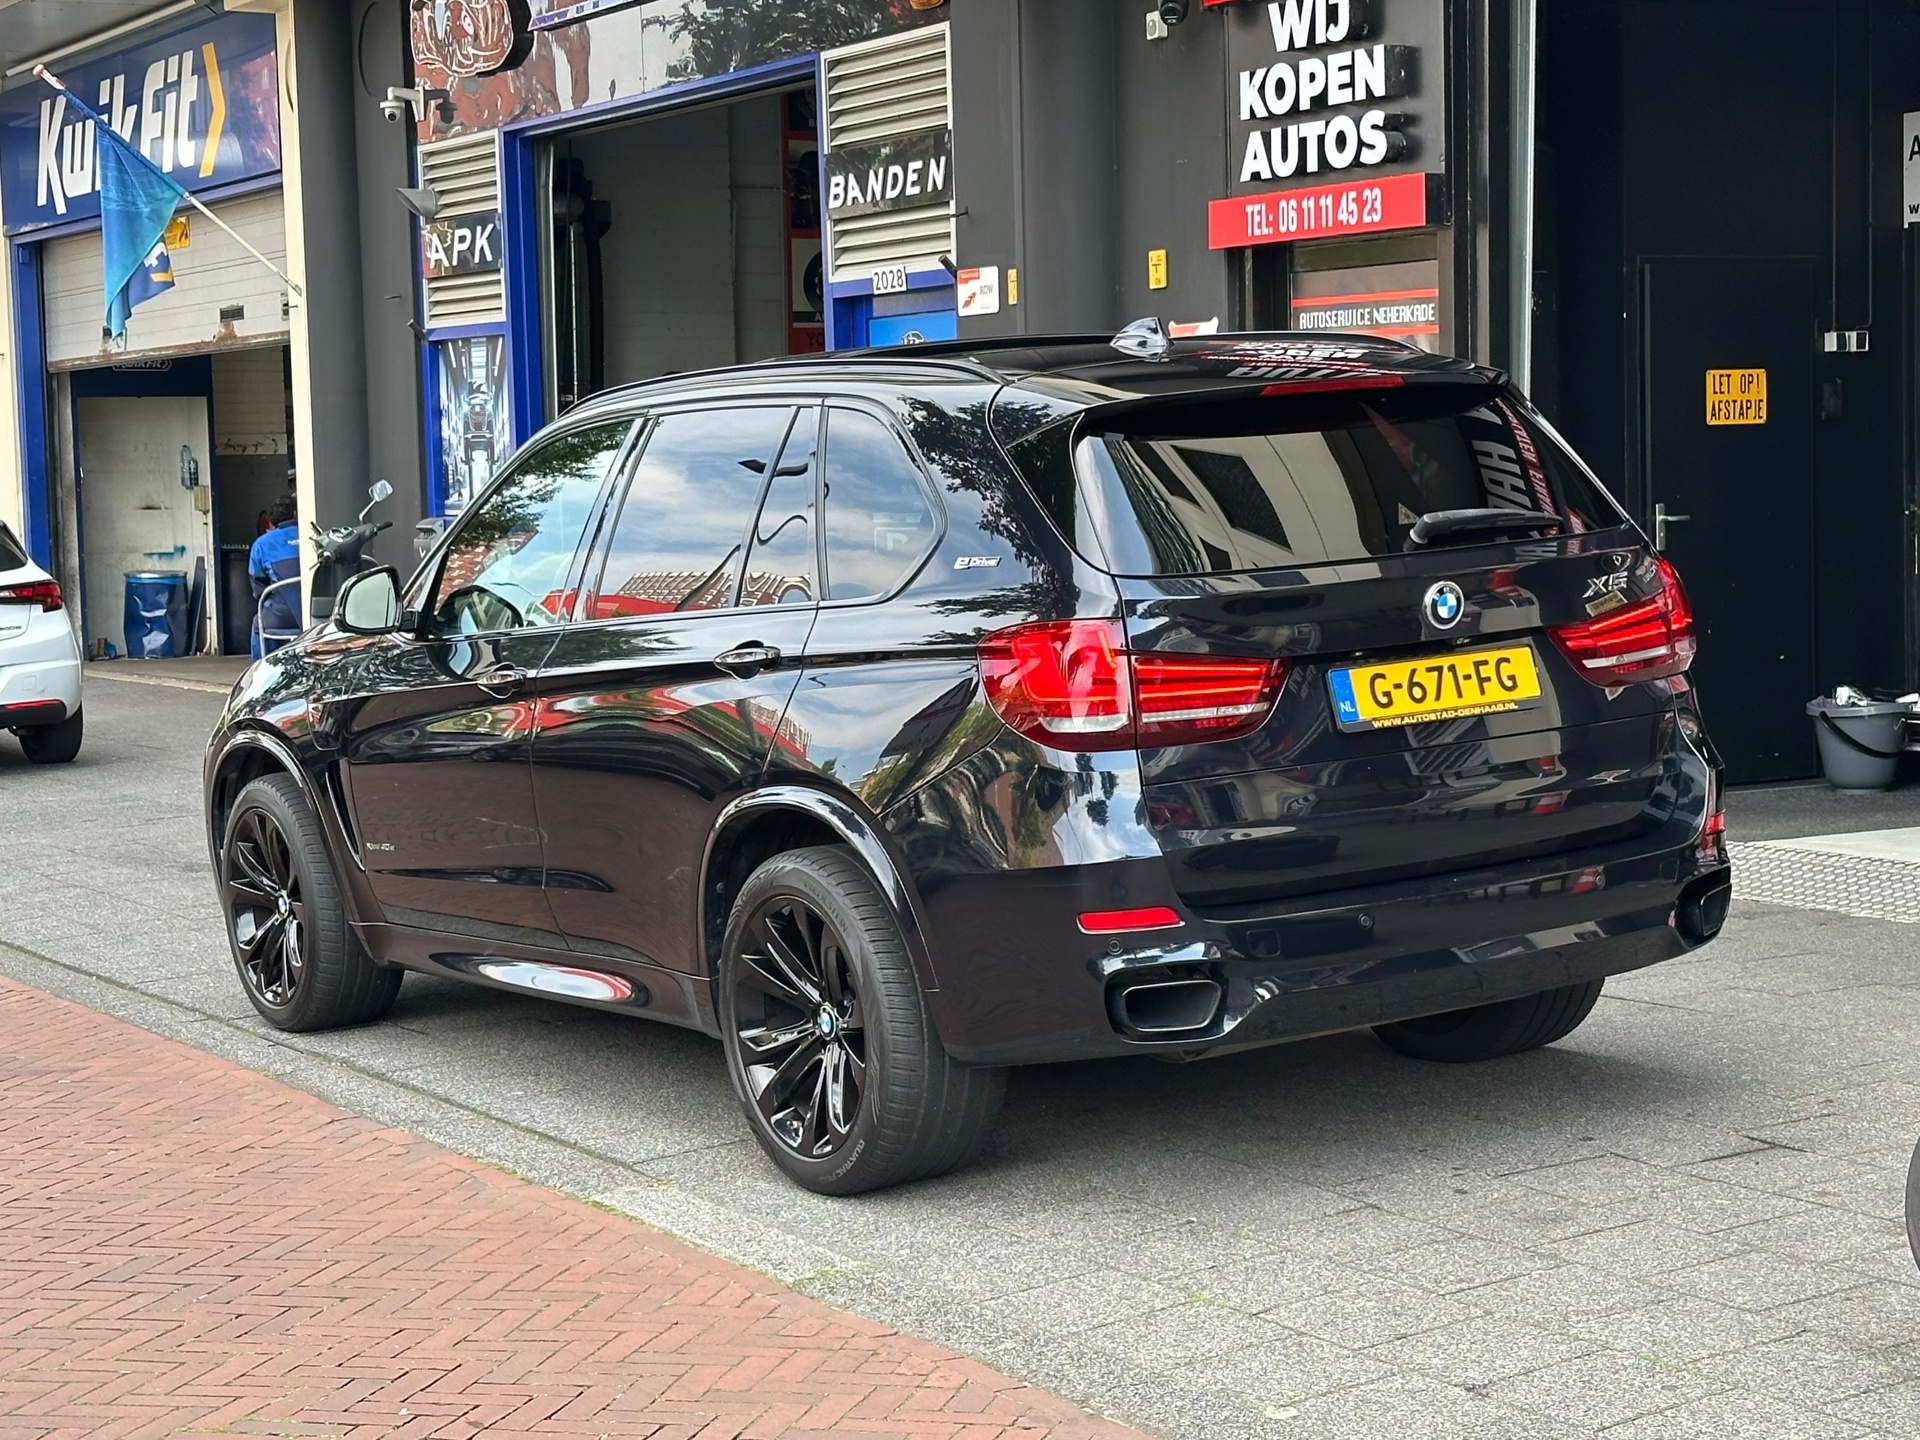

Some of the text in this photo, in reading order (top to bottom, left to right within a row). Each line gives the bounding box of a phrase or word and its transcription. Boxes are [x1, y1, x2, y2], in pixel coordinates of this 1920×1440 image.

[1268, 0, 1350, 52] WIJ
[1239, 44, 1386, 121] KOPEN
[1239, 109, 1388, 182] AUTOS
[828, 155, 946, 209] BANDEN
[1245, 187, 1382, 237] TEL: 06 11 11 45 23
[429, 223, 495, 269] APK
[874, 271, 904, 291] 2028
[1299, 303, 1435, 330] AUTOSERVICE NEHERKADE
[1712, 373, 1760, 395] LET OP!
[1710, 398, 1764, 421] AFSTAPJE
[1582, 571, 1628, 598] X5
[1368, 656, 1519, 709] G-671-FG
[1340, 702, 1356, 713] NL
